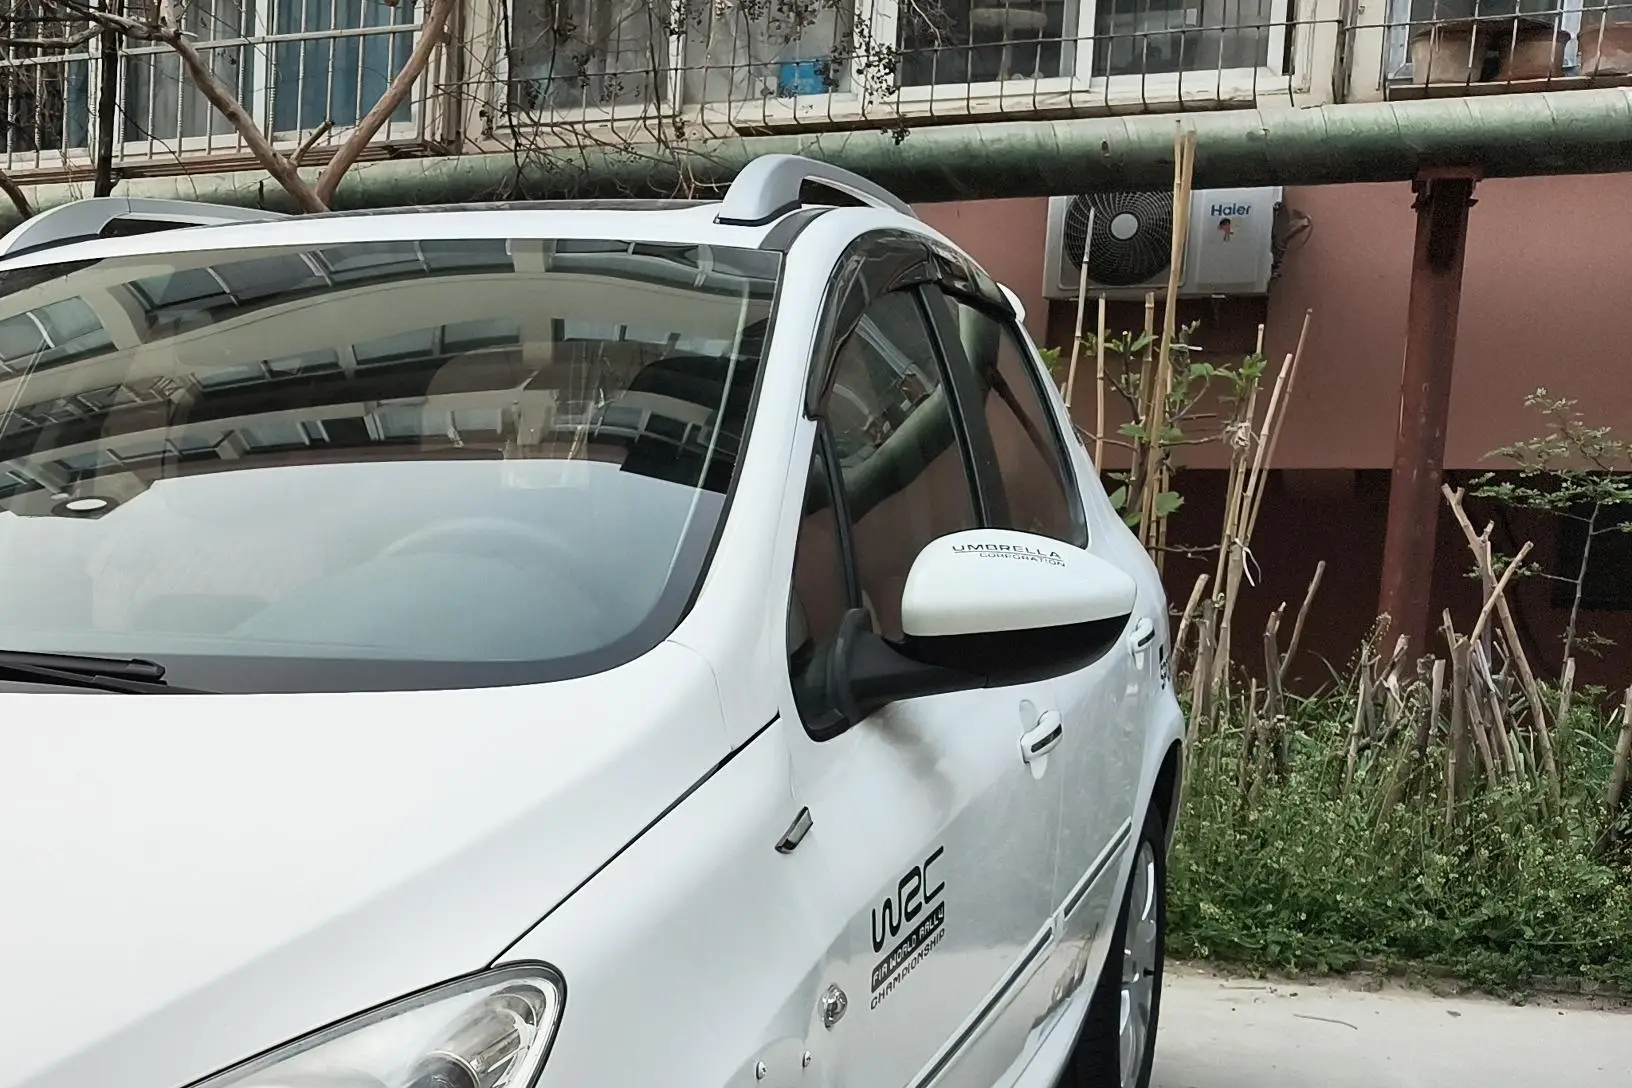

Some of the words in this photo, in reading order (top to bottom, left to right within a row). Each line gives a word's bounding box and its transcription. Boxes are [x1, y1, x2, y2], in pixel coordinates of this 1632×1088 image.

[1210, 203, 1251, 216] Haier
[952, 544, 1061, 559] UMBRELLA
[979, 552, 1066, 567] CORPORATION
[872, 845, 945, 953] WRC
[889, 934, 918, 971] WORLD
[870, 928, 945, 1010] CHAMPIONSHIP
